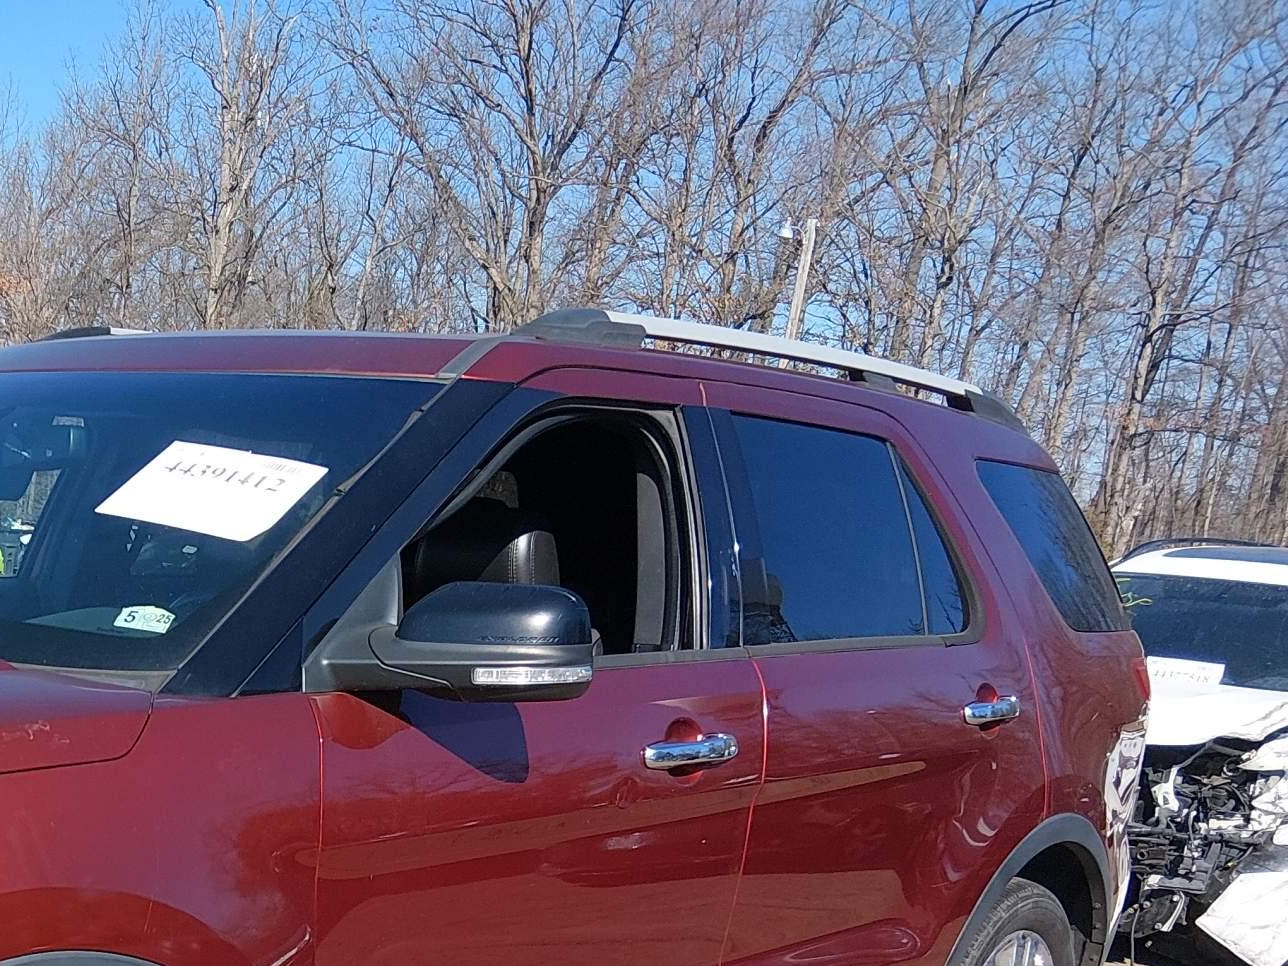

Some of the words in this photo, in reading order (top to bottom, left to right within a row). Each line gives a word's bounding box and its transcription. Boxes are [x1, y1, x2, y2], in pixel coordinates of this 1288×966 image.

[164, 461, 287, 492] 44391412
[123, 610, 139, 623] 5
[155, 613, 173, 625] 25
